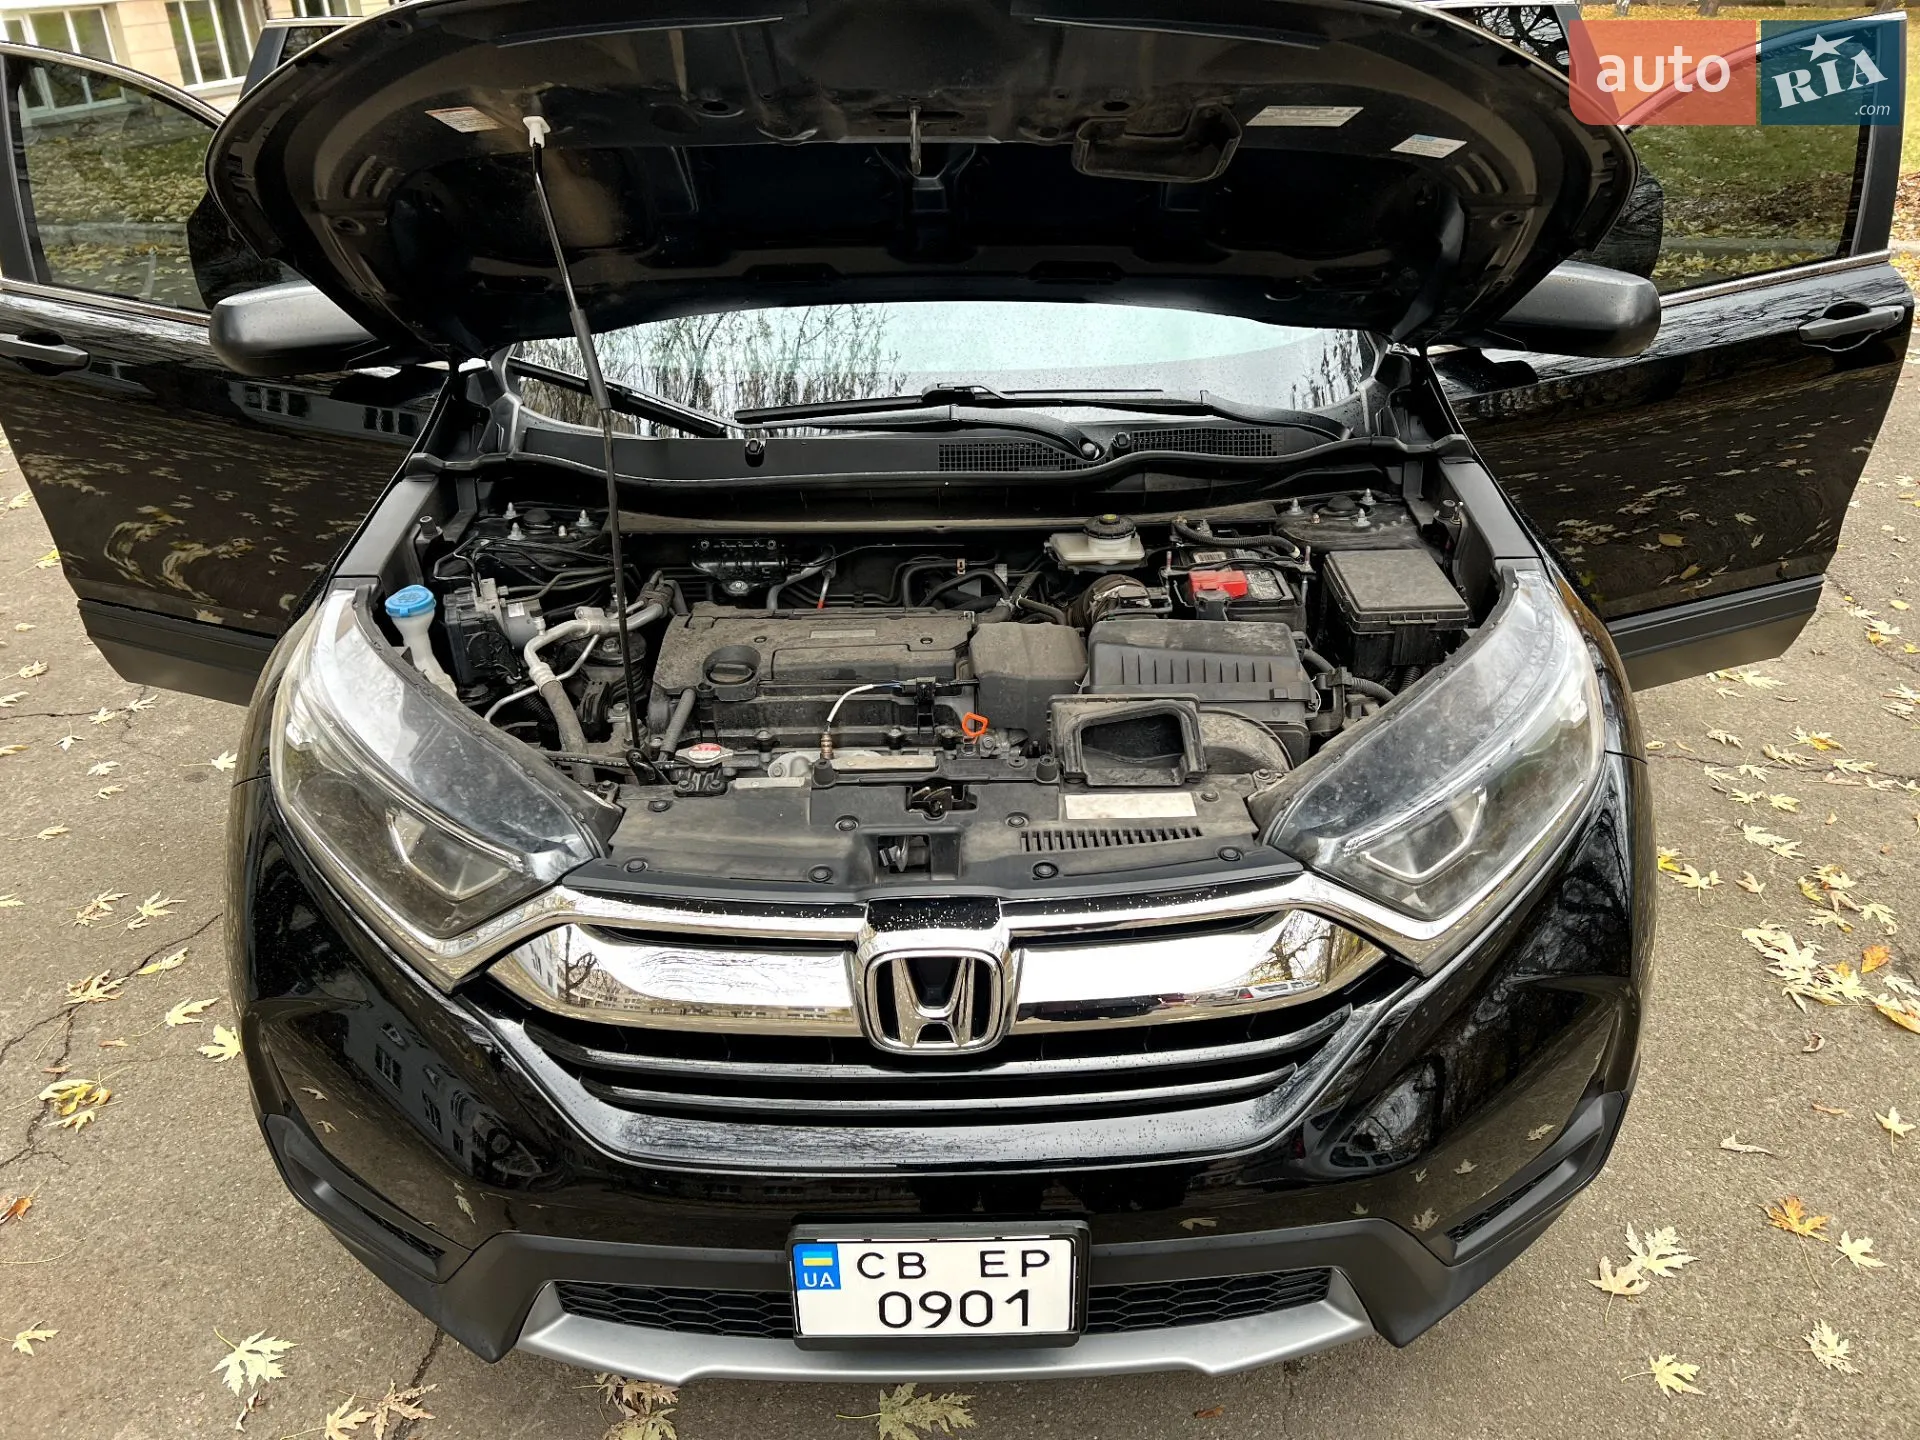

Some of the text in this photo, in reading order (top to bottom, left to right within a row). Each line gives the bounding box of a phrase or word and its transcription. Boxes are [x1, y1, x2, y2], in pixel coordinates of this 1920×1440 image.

[803, 1272, 835, 1288] UA
[856, 1249, 1051, 1280] CB EP
[878, 1288, 1030, 1329] 0901
